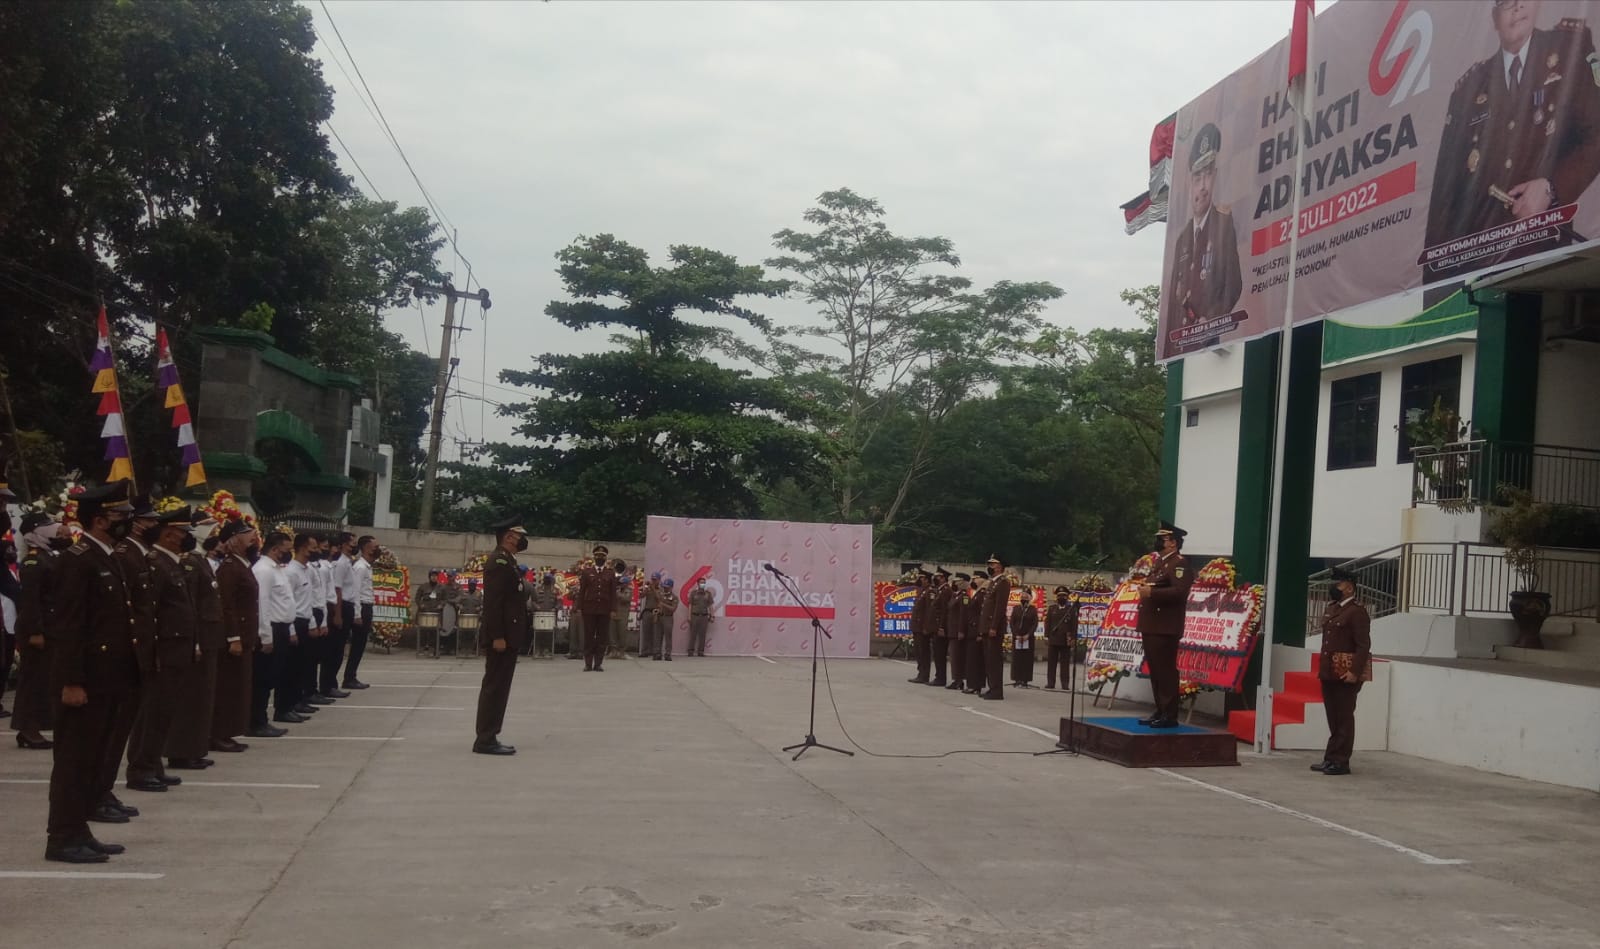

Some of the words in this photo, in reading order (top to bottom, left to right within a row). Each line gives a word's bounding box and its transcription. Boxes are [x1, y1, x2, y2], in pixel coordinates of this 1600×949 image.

[1261, 60, 1327, 128] HAI
[1258, 88, 1360, 173] BHAKTI
[1254, 113, 1418, 220] ADHYAKSA
[1300, 203, 1334, 234] JULI
[1337, 182, 1378, 218] 2022
[1296, 240, 1327, 262] HUKUM,
[1330, 224, 1369, 249] HUMANIS
[1370, 207, 1412, 233] MENUJU
[1427, 246, 1449, 260] RICKY
[1449, 238, 1479, 253] TOMMY
[1437, 256, 1459, 269] KEPALA
[1460, 246, 1496, 262] KEJAKSAAN
[1496, 237, 1518, 251] NEGERI
[1518, 230, 1549, 245] CIANJUR
[728, 558, 776, 575] HARI
[728, 573, 799, 592] BHAKTI
[727, 590, 834, 608] ADHYAKSA
